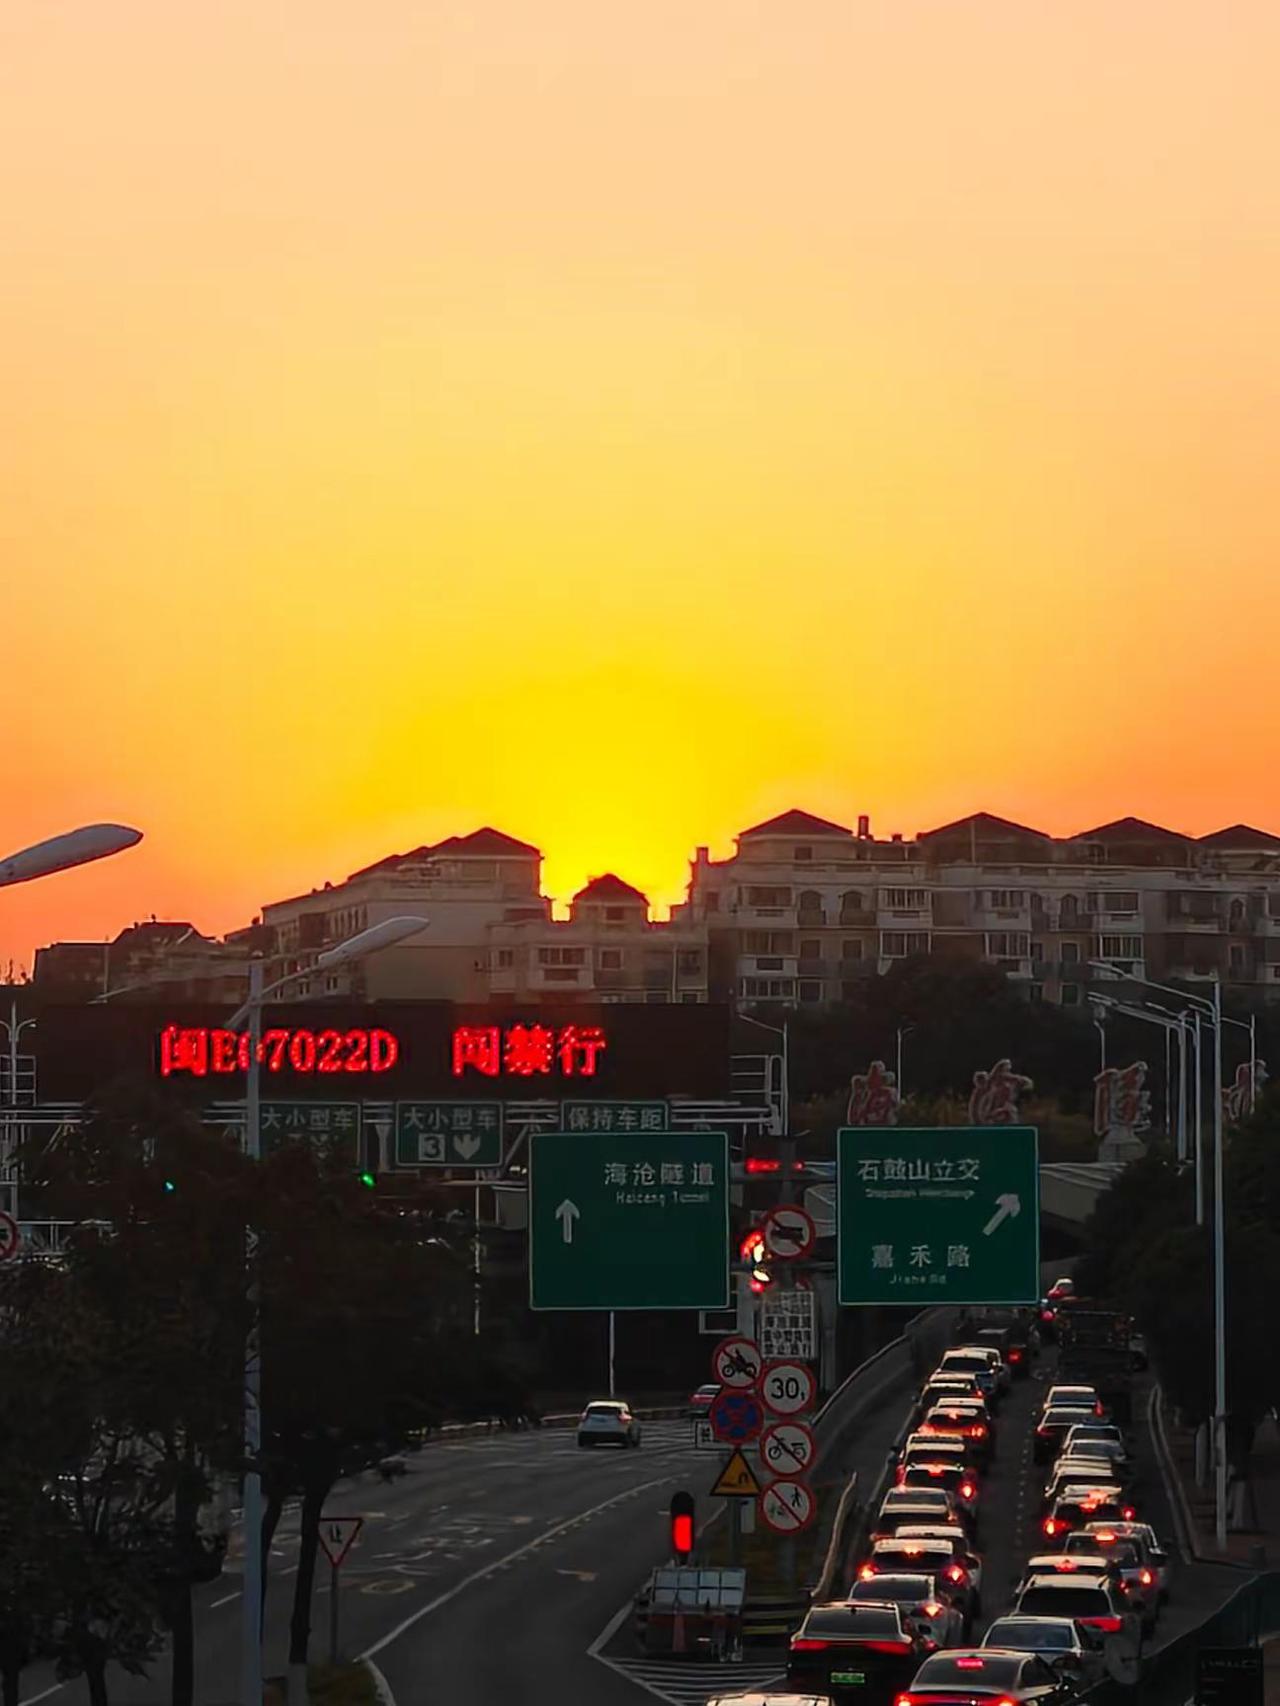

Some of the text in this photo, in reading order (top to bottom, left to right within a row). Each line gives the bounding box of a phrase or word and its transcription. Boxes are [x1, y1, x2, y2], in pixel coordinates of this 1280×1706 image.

[261, 1107, 353, 1131] 大小型车
[404, 1106, 496, 1131] 大小型车
[568, 1106, 663, 1130] 保持车距
[423, 1135, 440, 1158] 3
[604, 1162, 715, 1186] 海沧隧道
[857, 1158, 980, 1182] 石鼓山立交
[871, 1244, 970, 1268] 嘉禾路
